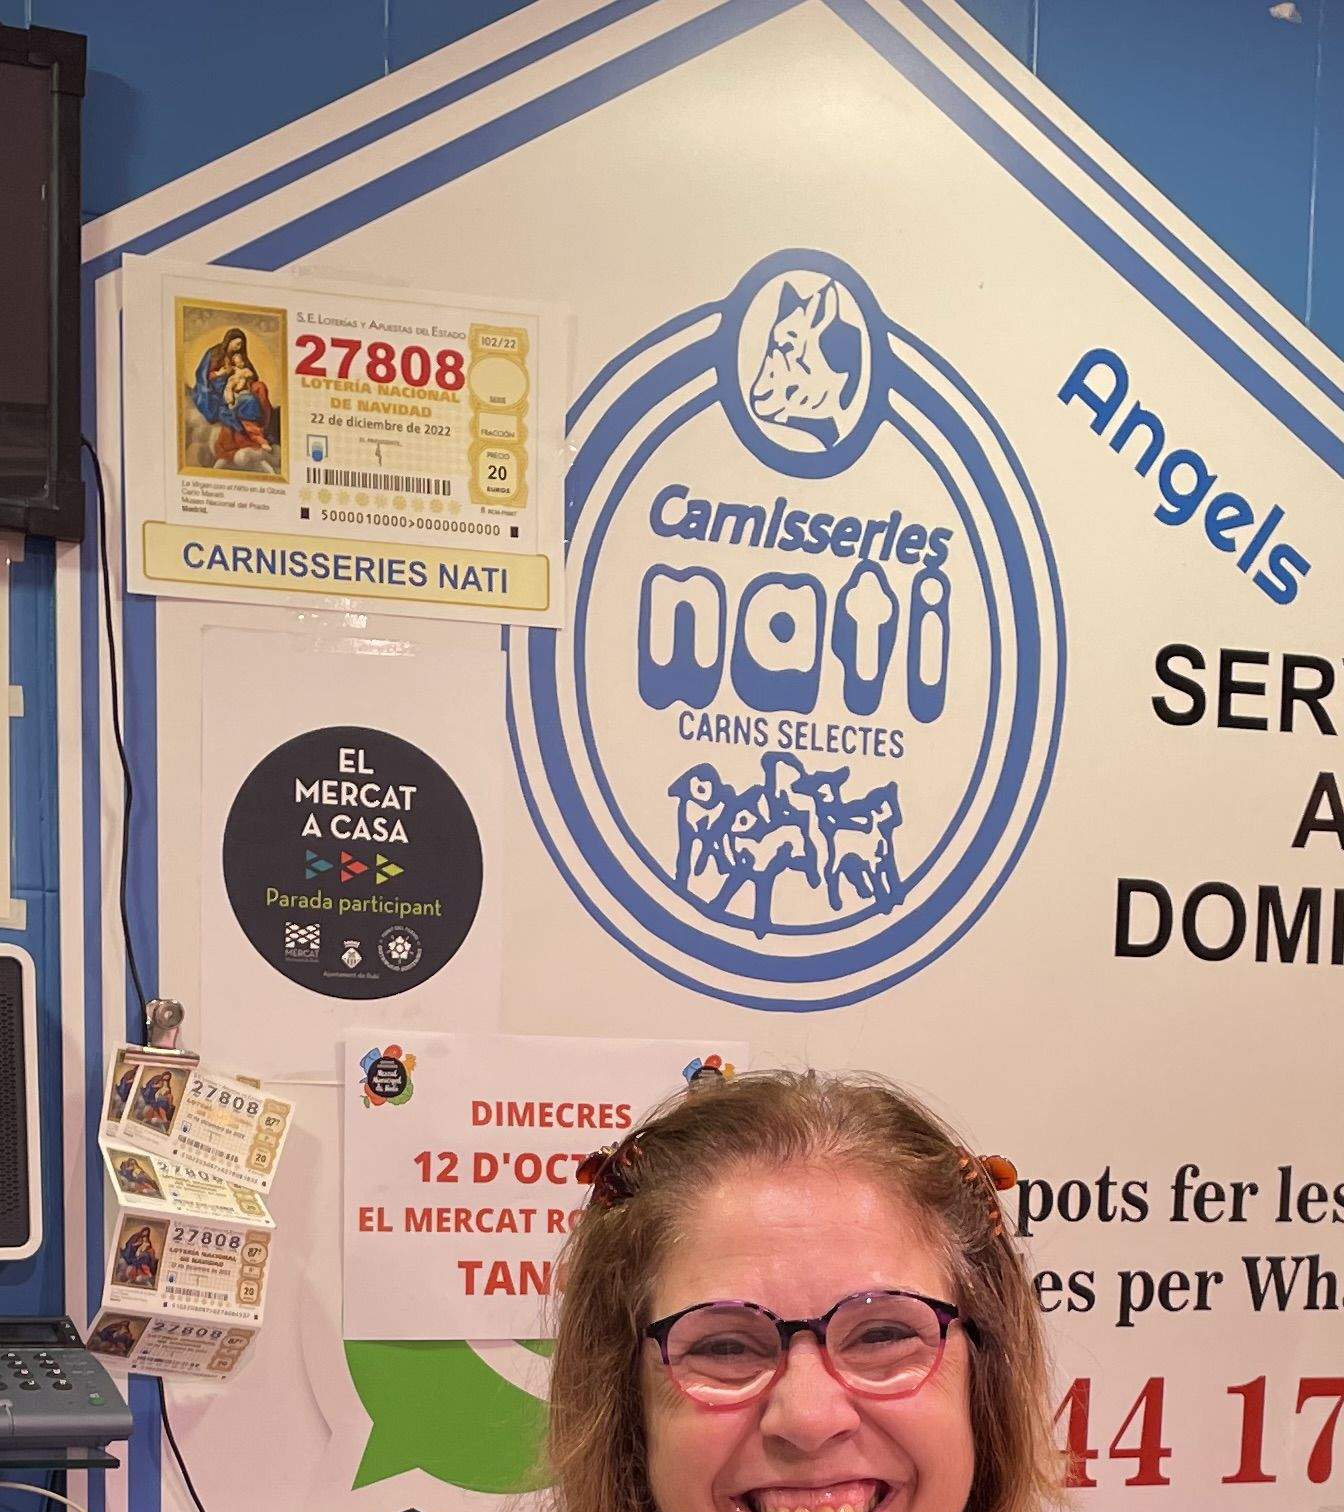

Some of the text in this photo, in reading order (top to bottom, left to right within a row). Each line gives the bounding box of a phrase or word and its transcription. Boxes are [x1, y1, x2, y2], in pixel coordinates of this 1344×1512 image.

[295, 334, 465, 391] 27808
[301, 377, 461, 404] LOTERÍA NACIONAL
[330, 397, 432, 418] DE NAVIDAD
[310, 413, 451, 436] 22 de diciembre de 2022
[488, 465, 507, 481] 20
[1057, 348, 1311, 605] Angels
[649, 483, 954, 570] Carnisseries
[182, 541, 508, 594] CARNISSERIES NATI
[637, 558, 952, 724] nati
[679, 711, 905, 760] CARNS SELECTES
[339, 747, 374, 775] EL
[295, 777, 417, 811] MERCAT
[302, 812, 409, 843] A CASA
[266, 887, 442, 918] Parada participant
[191, 1080, 259, 1115] 27808
[472, 1100, 632, 1130] DIMECRES
[414, 1151, 458, 1183] 12
[1015, 1165, 1149, 1237] pots
[1171, 1163, 1258, 1223] fer
[359, 1206, 393, 1232] EL
[405, 1206, 536, 1233] MERCAT
[173, 1228, 241, 1249] 27808
[1116, 1269, 1223, 1328] per
[1052, 1377, 1173, 1487] 44
